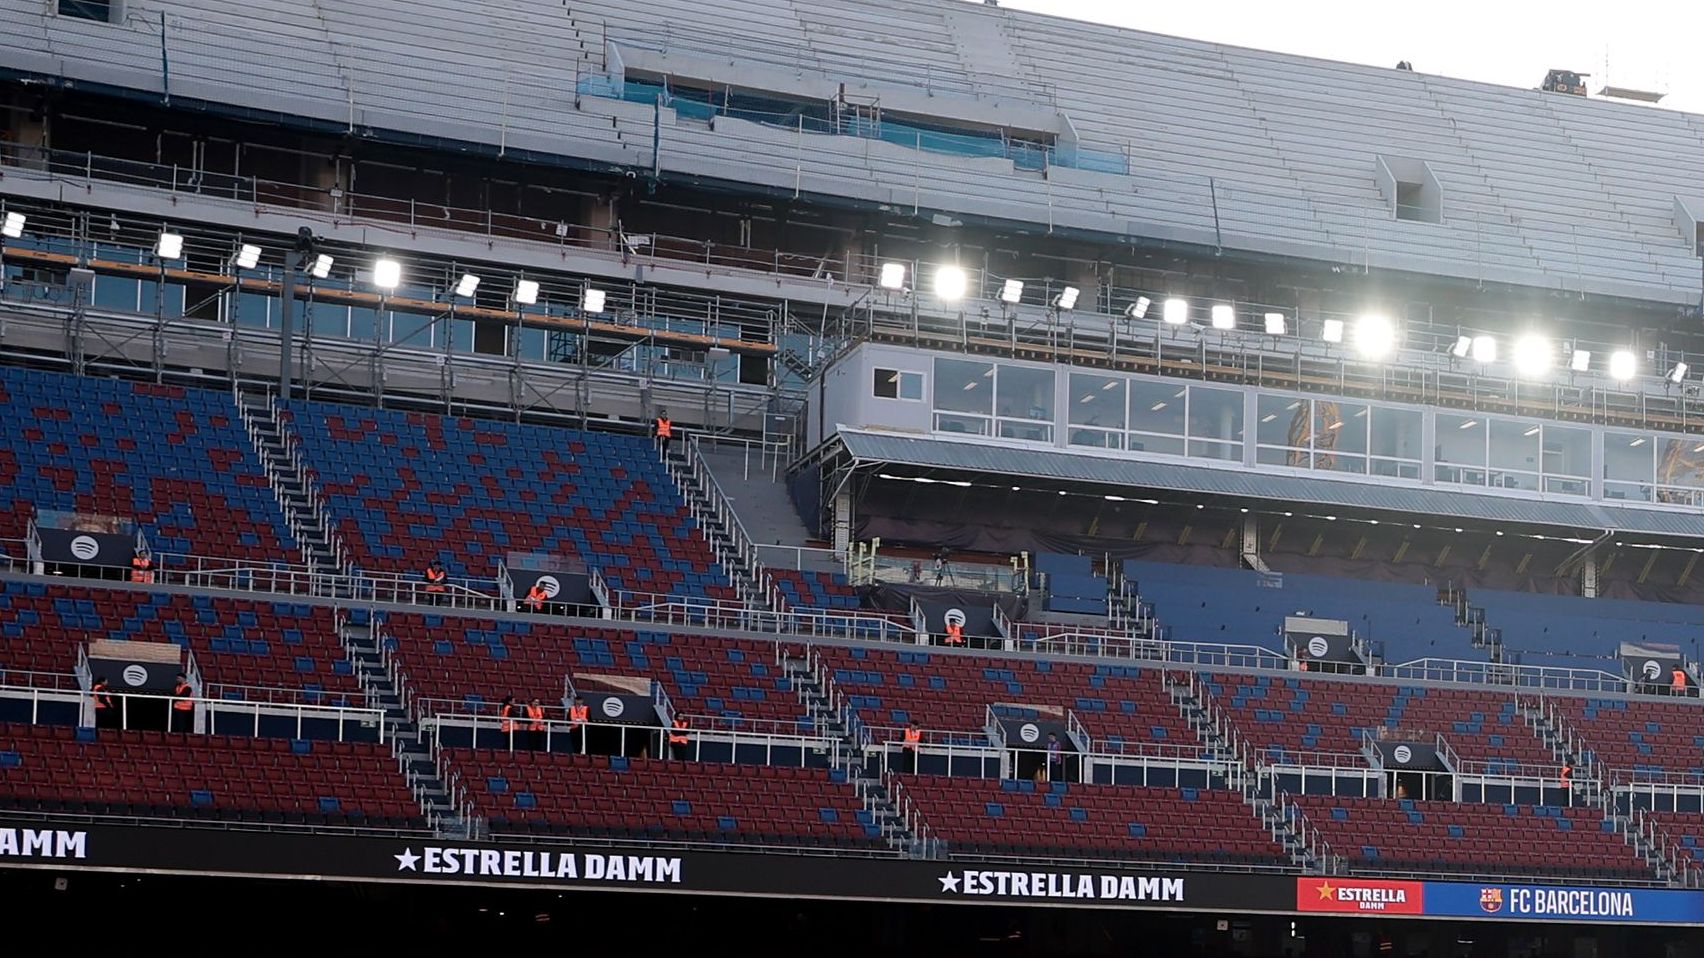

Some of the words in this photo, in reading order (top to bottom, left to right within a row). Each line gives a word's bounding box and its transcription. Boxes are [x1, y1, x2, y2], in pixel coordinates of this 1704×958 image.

[423, 847, 578, 879] ESTRELLA
[584, 853, 682, 883] DAMM
[963, 870, 1095, 898] ESTRELLA
[1100, 875, 1184, 901] DAMM
[1337, 887, 1406, 903] ESTRELLA
[1359, 901, 1385, 910] DAMM
[1510, 888, 1531, 913] FC
[1534, 889, 1634, 917] BARCELONA
